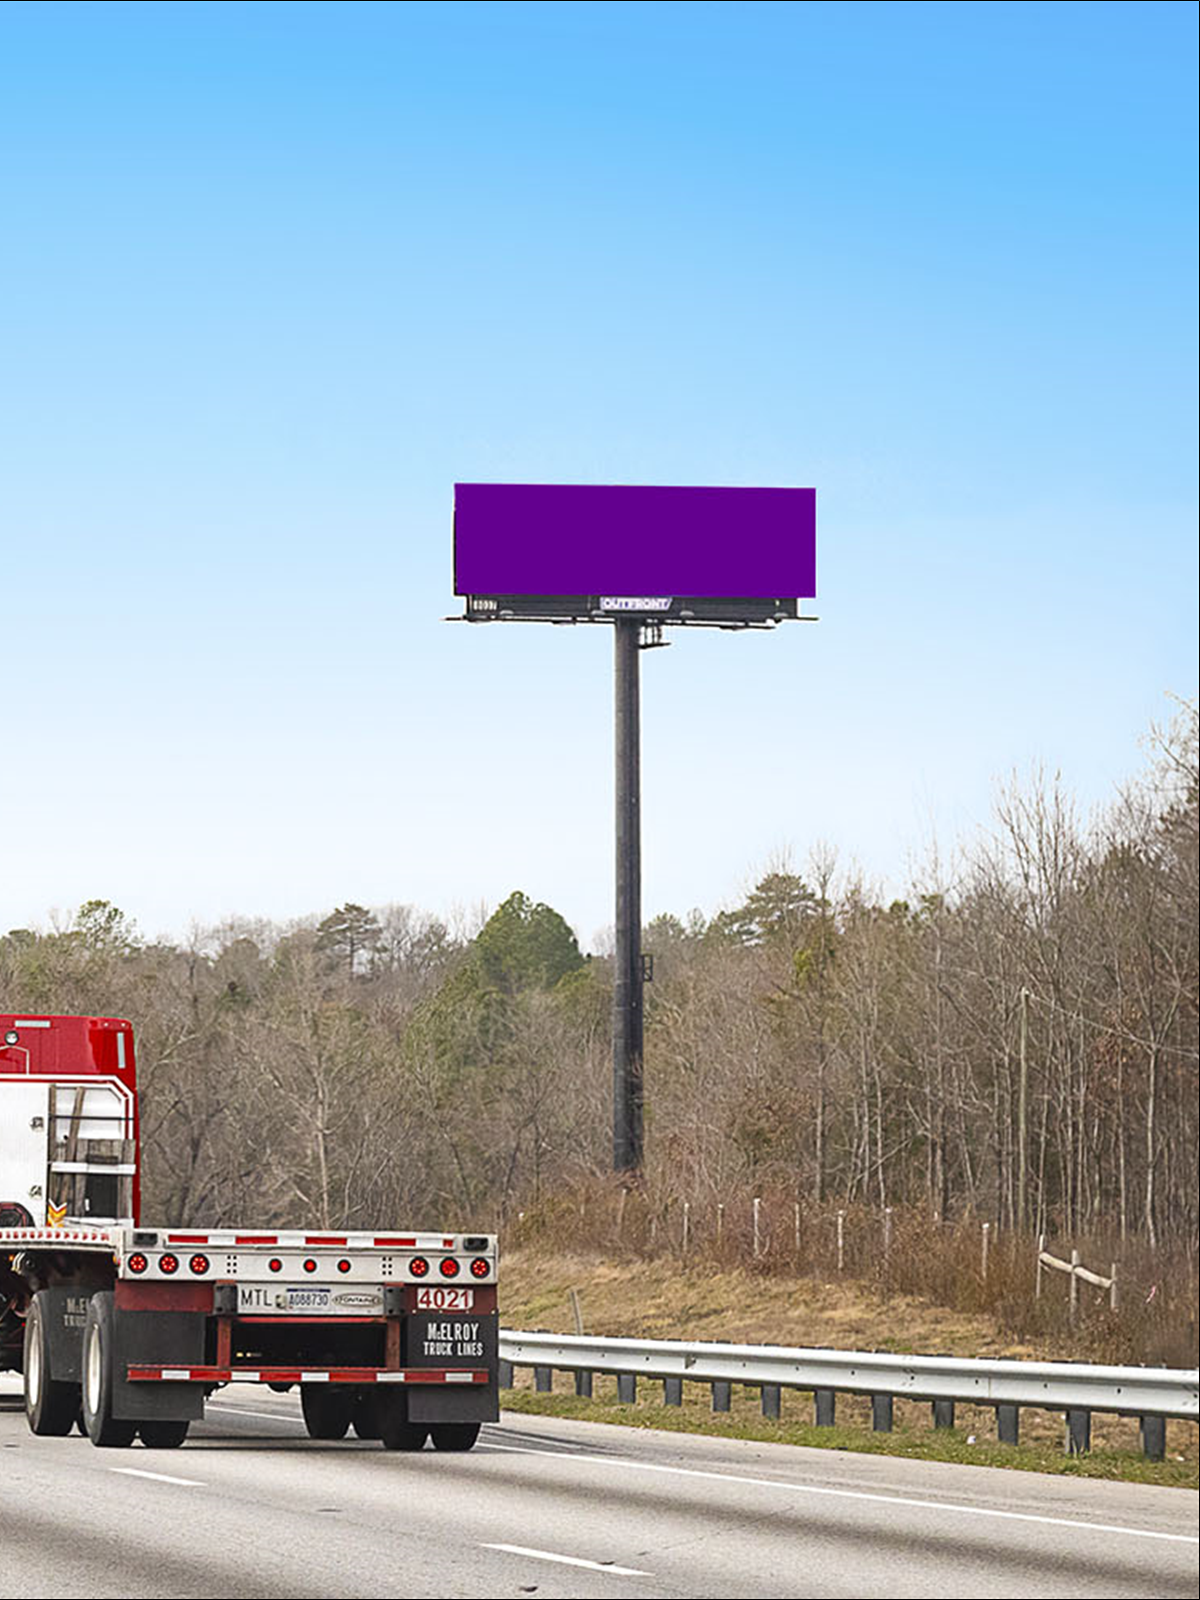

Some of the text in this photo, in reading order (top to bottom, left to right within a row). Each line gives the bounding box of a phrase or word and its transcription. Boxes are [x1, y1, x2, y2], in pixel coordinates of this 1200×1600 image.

[241, 1289, 272, 1306] MTL
[419, 1288, 468, 1308] 4021
[423, 1342, 483, 1356] TRUCK LINES
